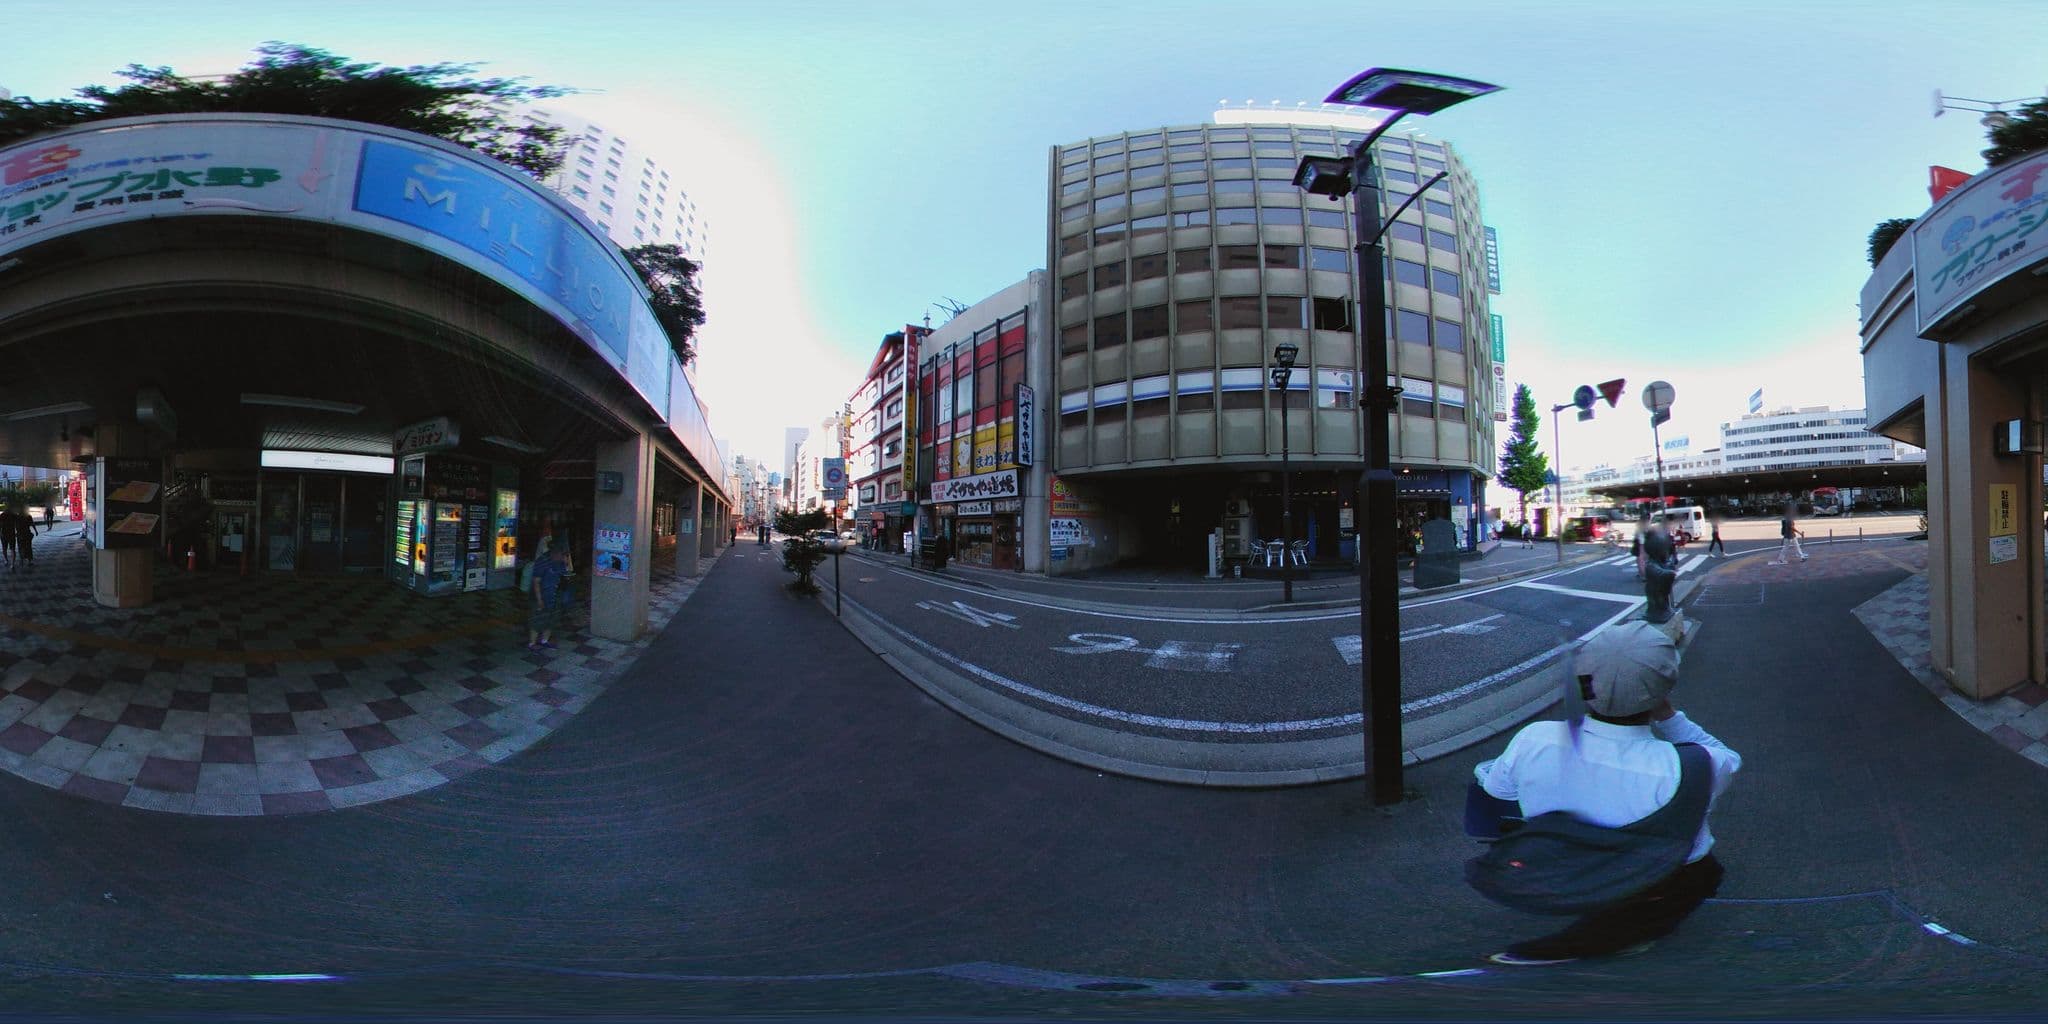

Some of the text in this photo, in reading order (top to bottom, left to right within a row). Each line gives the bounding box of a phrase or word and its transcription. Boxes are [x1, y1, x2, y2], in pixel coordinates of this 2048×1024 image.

[403, 176, 623, 336] MILLION
[1020, 399, 1032, 464] さかなや道場
[946, 474, 1016, 499] さかなや道場
